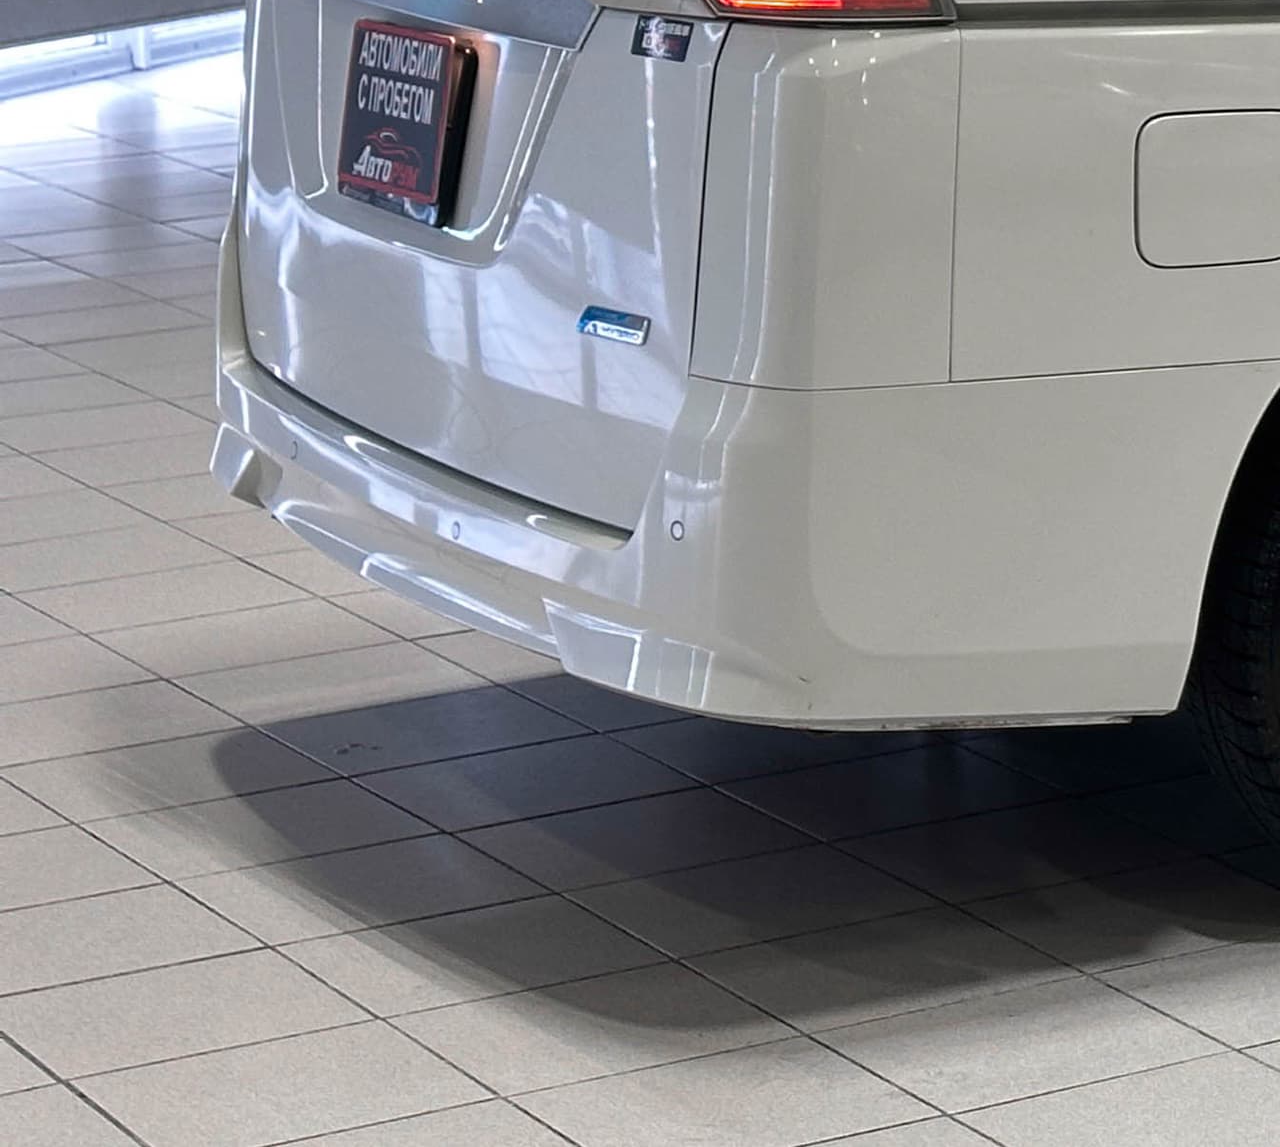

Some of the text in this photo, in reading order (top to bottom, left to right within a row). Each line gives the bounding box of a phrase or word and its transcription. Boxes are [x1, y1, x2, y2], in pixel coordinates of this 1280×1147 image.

[358, 31, 443, 82] АВТОМОБИЛИ
[358, 73, 434, 125] С ПРОБЕГОМ
